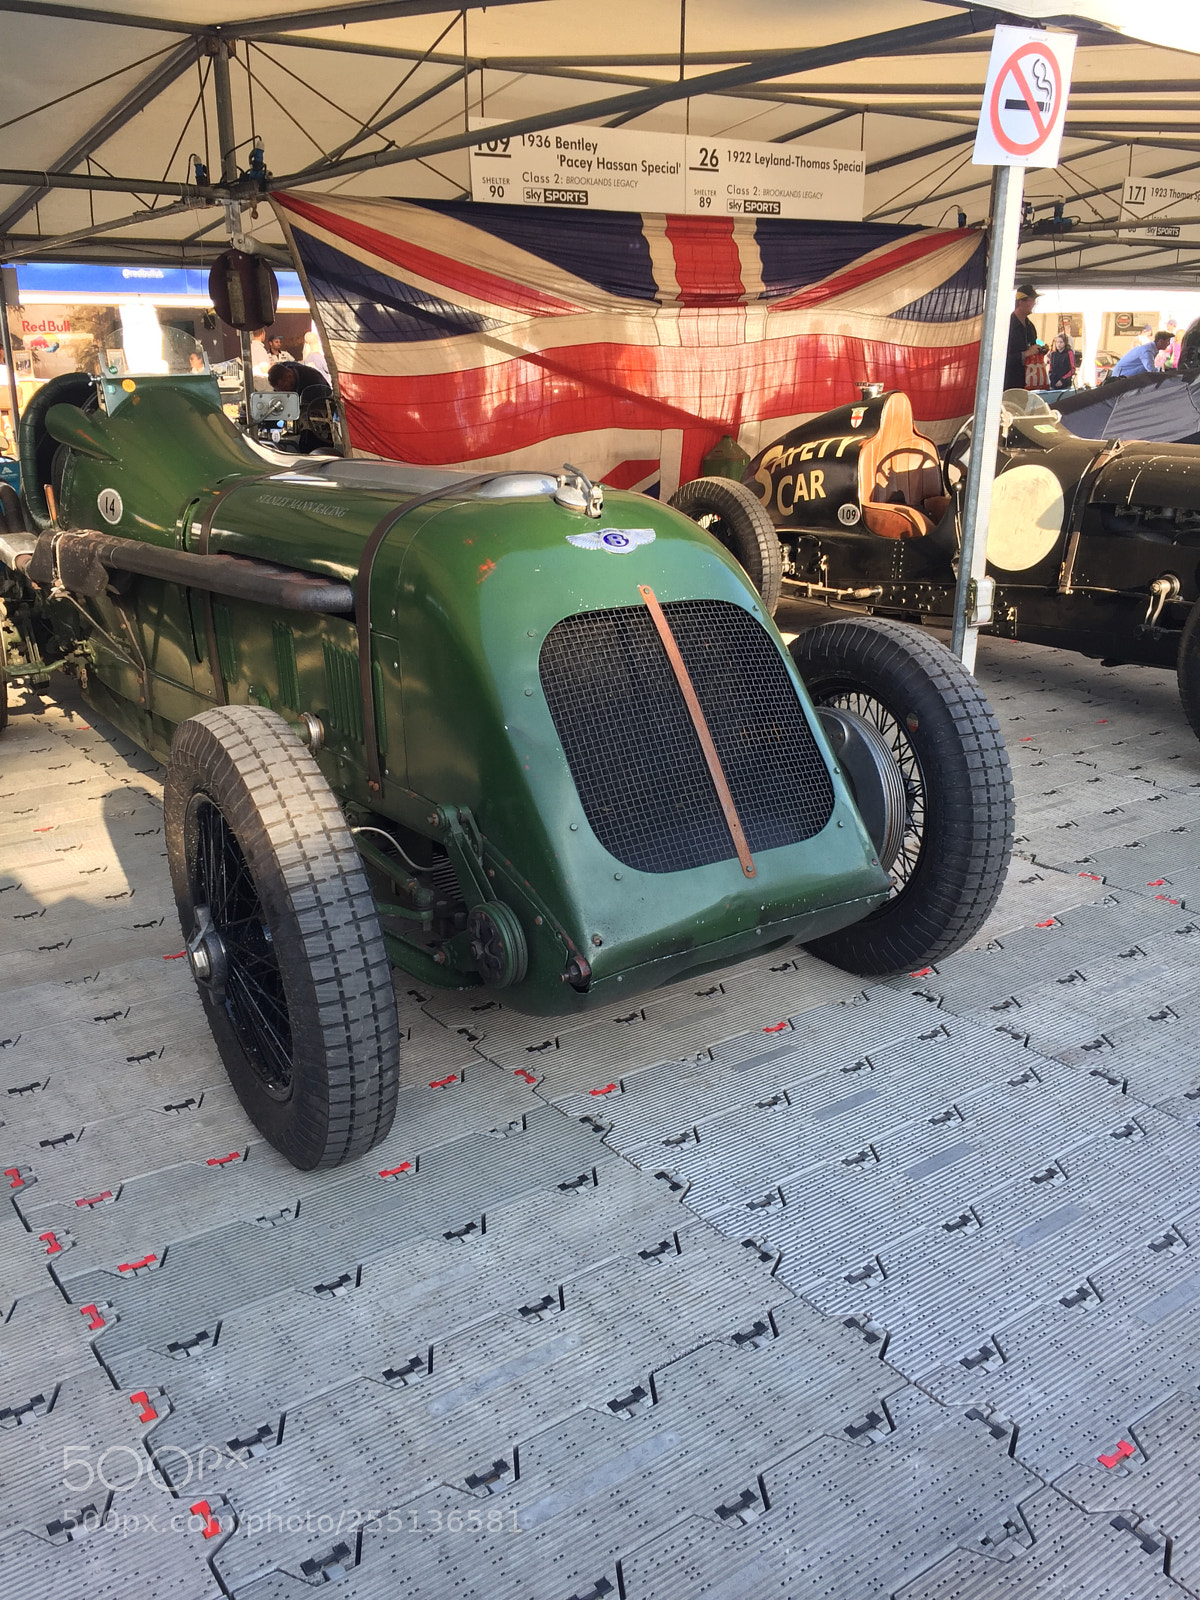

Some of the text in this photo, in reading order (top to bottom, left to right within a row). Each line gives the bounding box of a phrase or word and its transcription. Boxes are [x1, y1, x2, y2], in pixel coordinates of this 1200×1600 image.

[521, 133, 598, 155] 1936 Bentley
[556, 153, 681, 177] 'Pacey Hassan Special'
[699, 147, 719, 168] 26
[727, 150, 864, 174] 1922 Leyland-Thomas Special
[482, 176, 511, 185] SHELTER
[522, 171, 639, 189] Class 2: BROOKLANDS LEGACY
[489, 185, 505, 198] 90
[525, 188, 588, 205] sky SPORTS
[693, 188, 717, 197] SHELTER
[726, 184, 824, 200] Class 2: BROOKLANDS LEGACY
[1129, 185, 1147, 201] 171
[1151, 187, 1168, 198] 1923
[699, 196, 712, 208] 89
[728, 199, 780, 214] sky SPORTS
[1157, 227, 1180, 236] SPORTS
[22, 320, 71, 332] Red Bull
[777, 469, 827, 516] CAR
[105, 496, 115, 516] 14
[841, 511, 857, 521] 109
